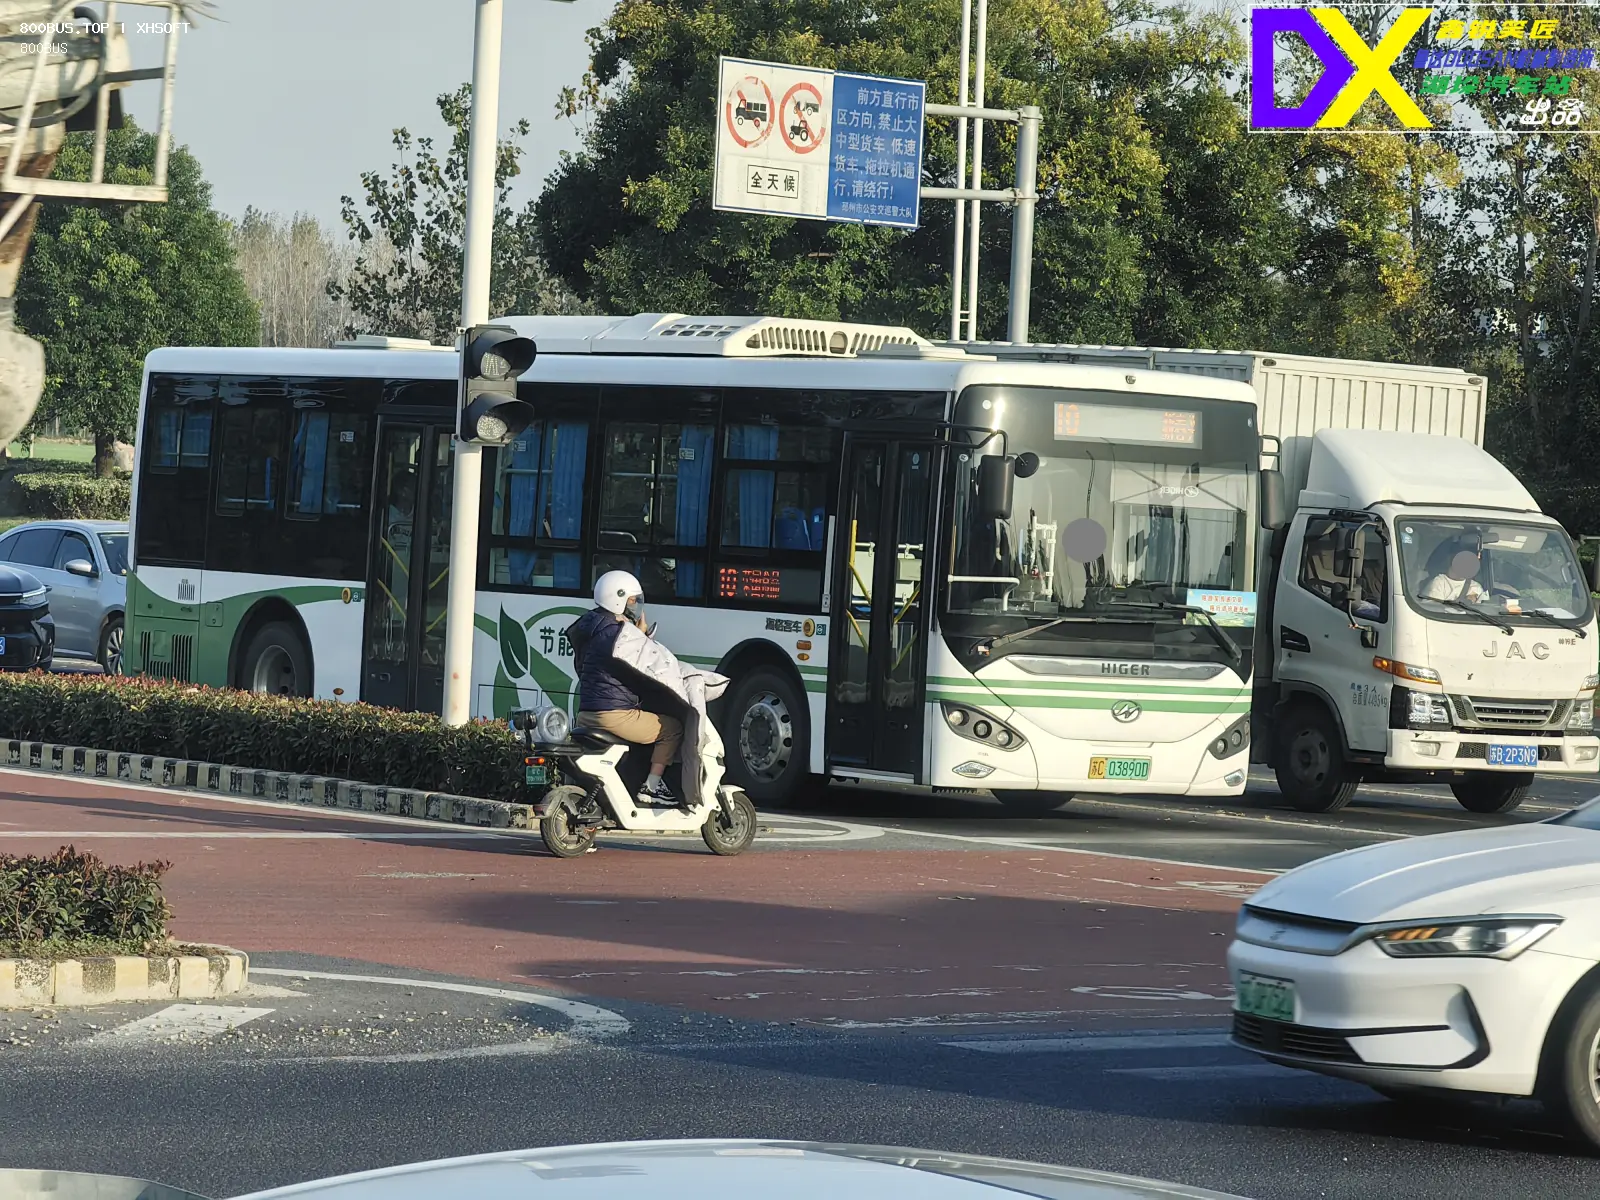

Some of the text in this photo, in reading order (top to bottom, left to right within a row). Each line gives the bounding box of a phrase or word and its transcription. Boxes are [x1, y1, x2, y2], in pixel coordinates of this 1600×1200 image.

[856, 86, 920, 111] 前方直行市
[750, 171, 797, 193] 全天候
[1482, 640, 1550, 661] JAC
[1101, 661, 1151, 677] HIGER
